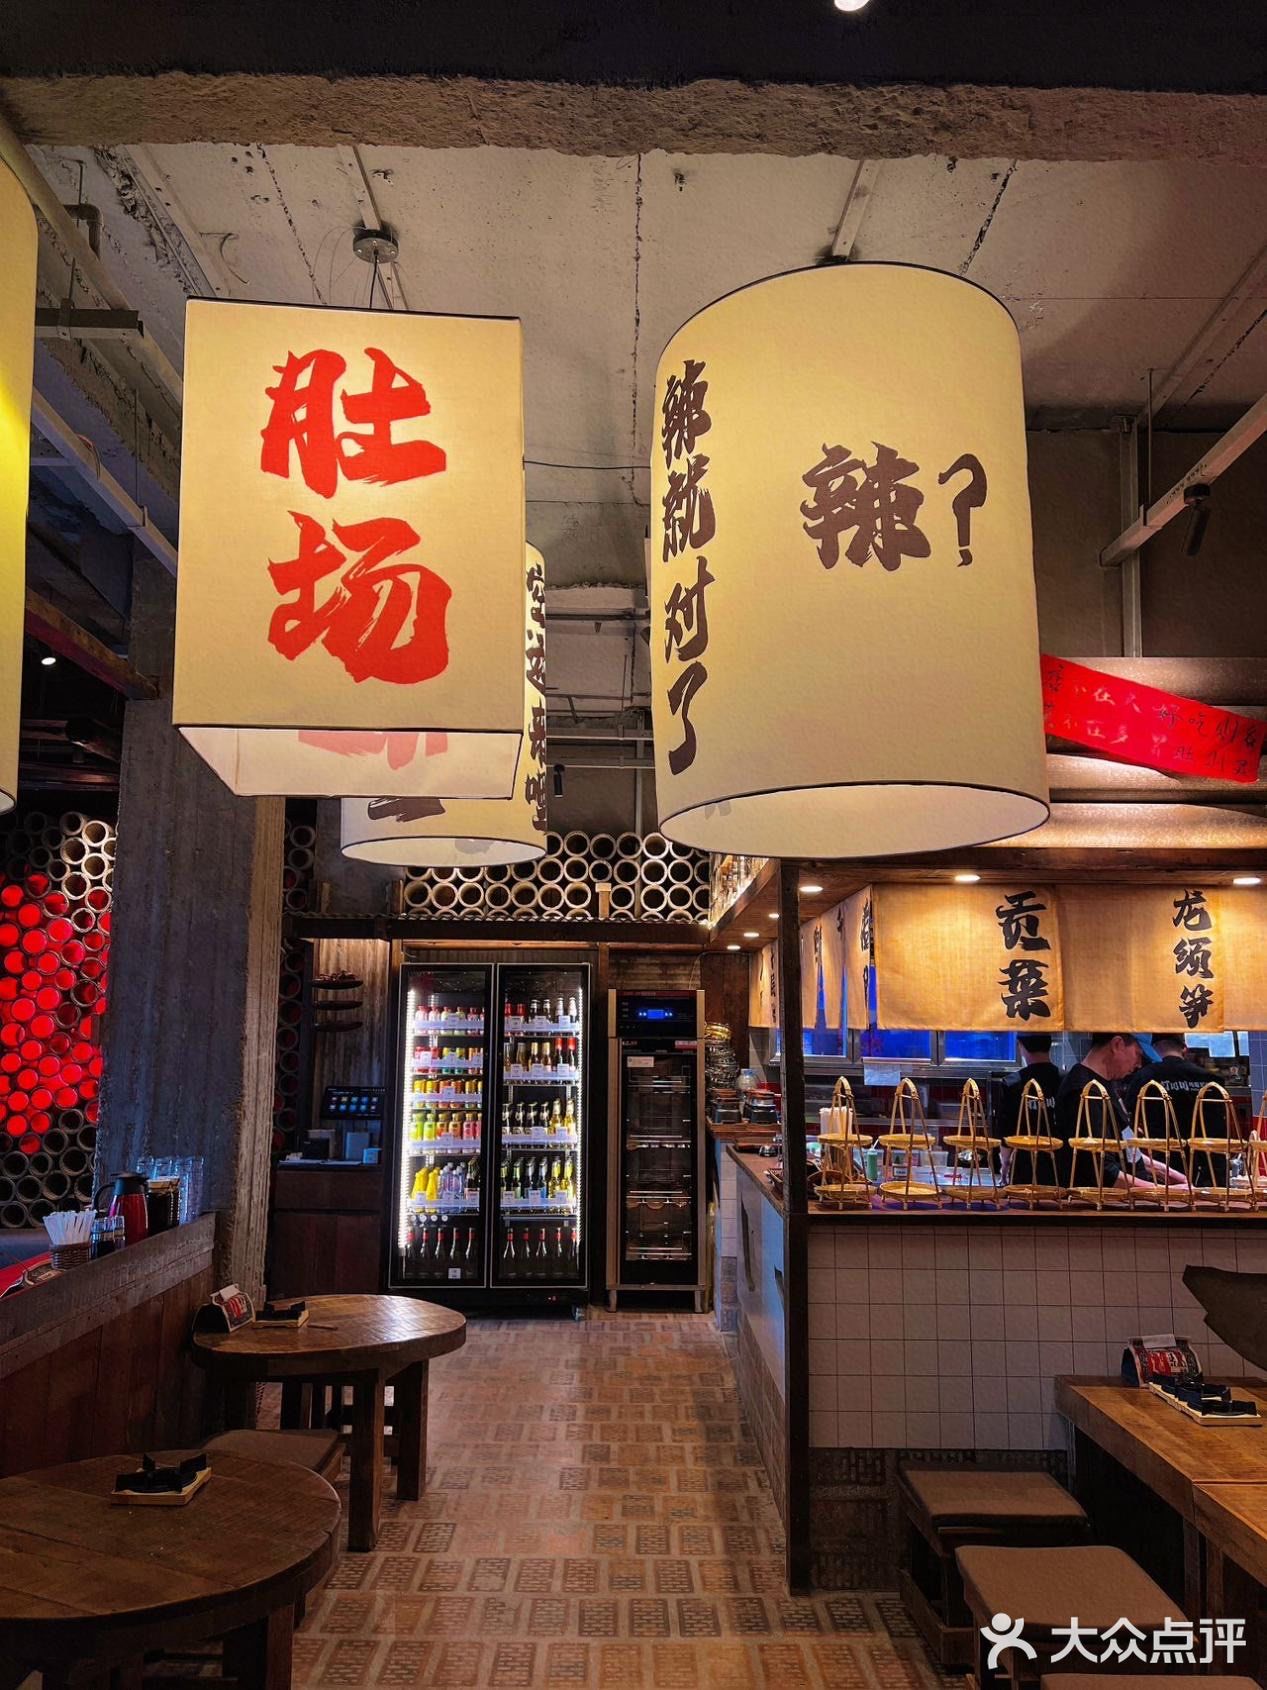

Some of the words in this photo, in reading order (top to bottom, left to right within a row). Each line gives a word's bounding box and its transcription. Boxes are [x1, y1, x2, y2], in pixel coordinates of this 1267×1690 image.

[261, 347, 452, 685] 肚场
[799, 441, 988, 572] 辣?
[996, 890, 1052, 1022] 贡菜
[1171, 889, 1216, 1029] 龙须笋
